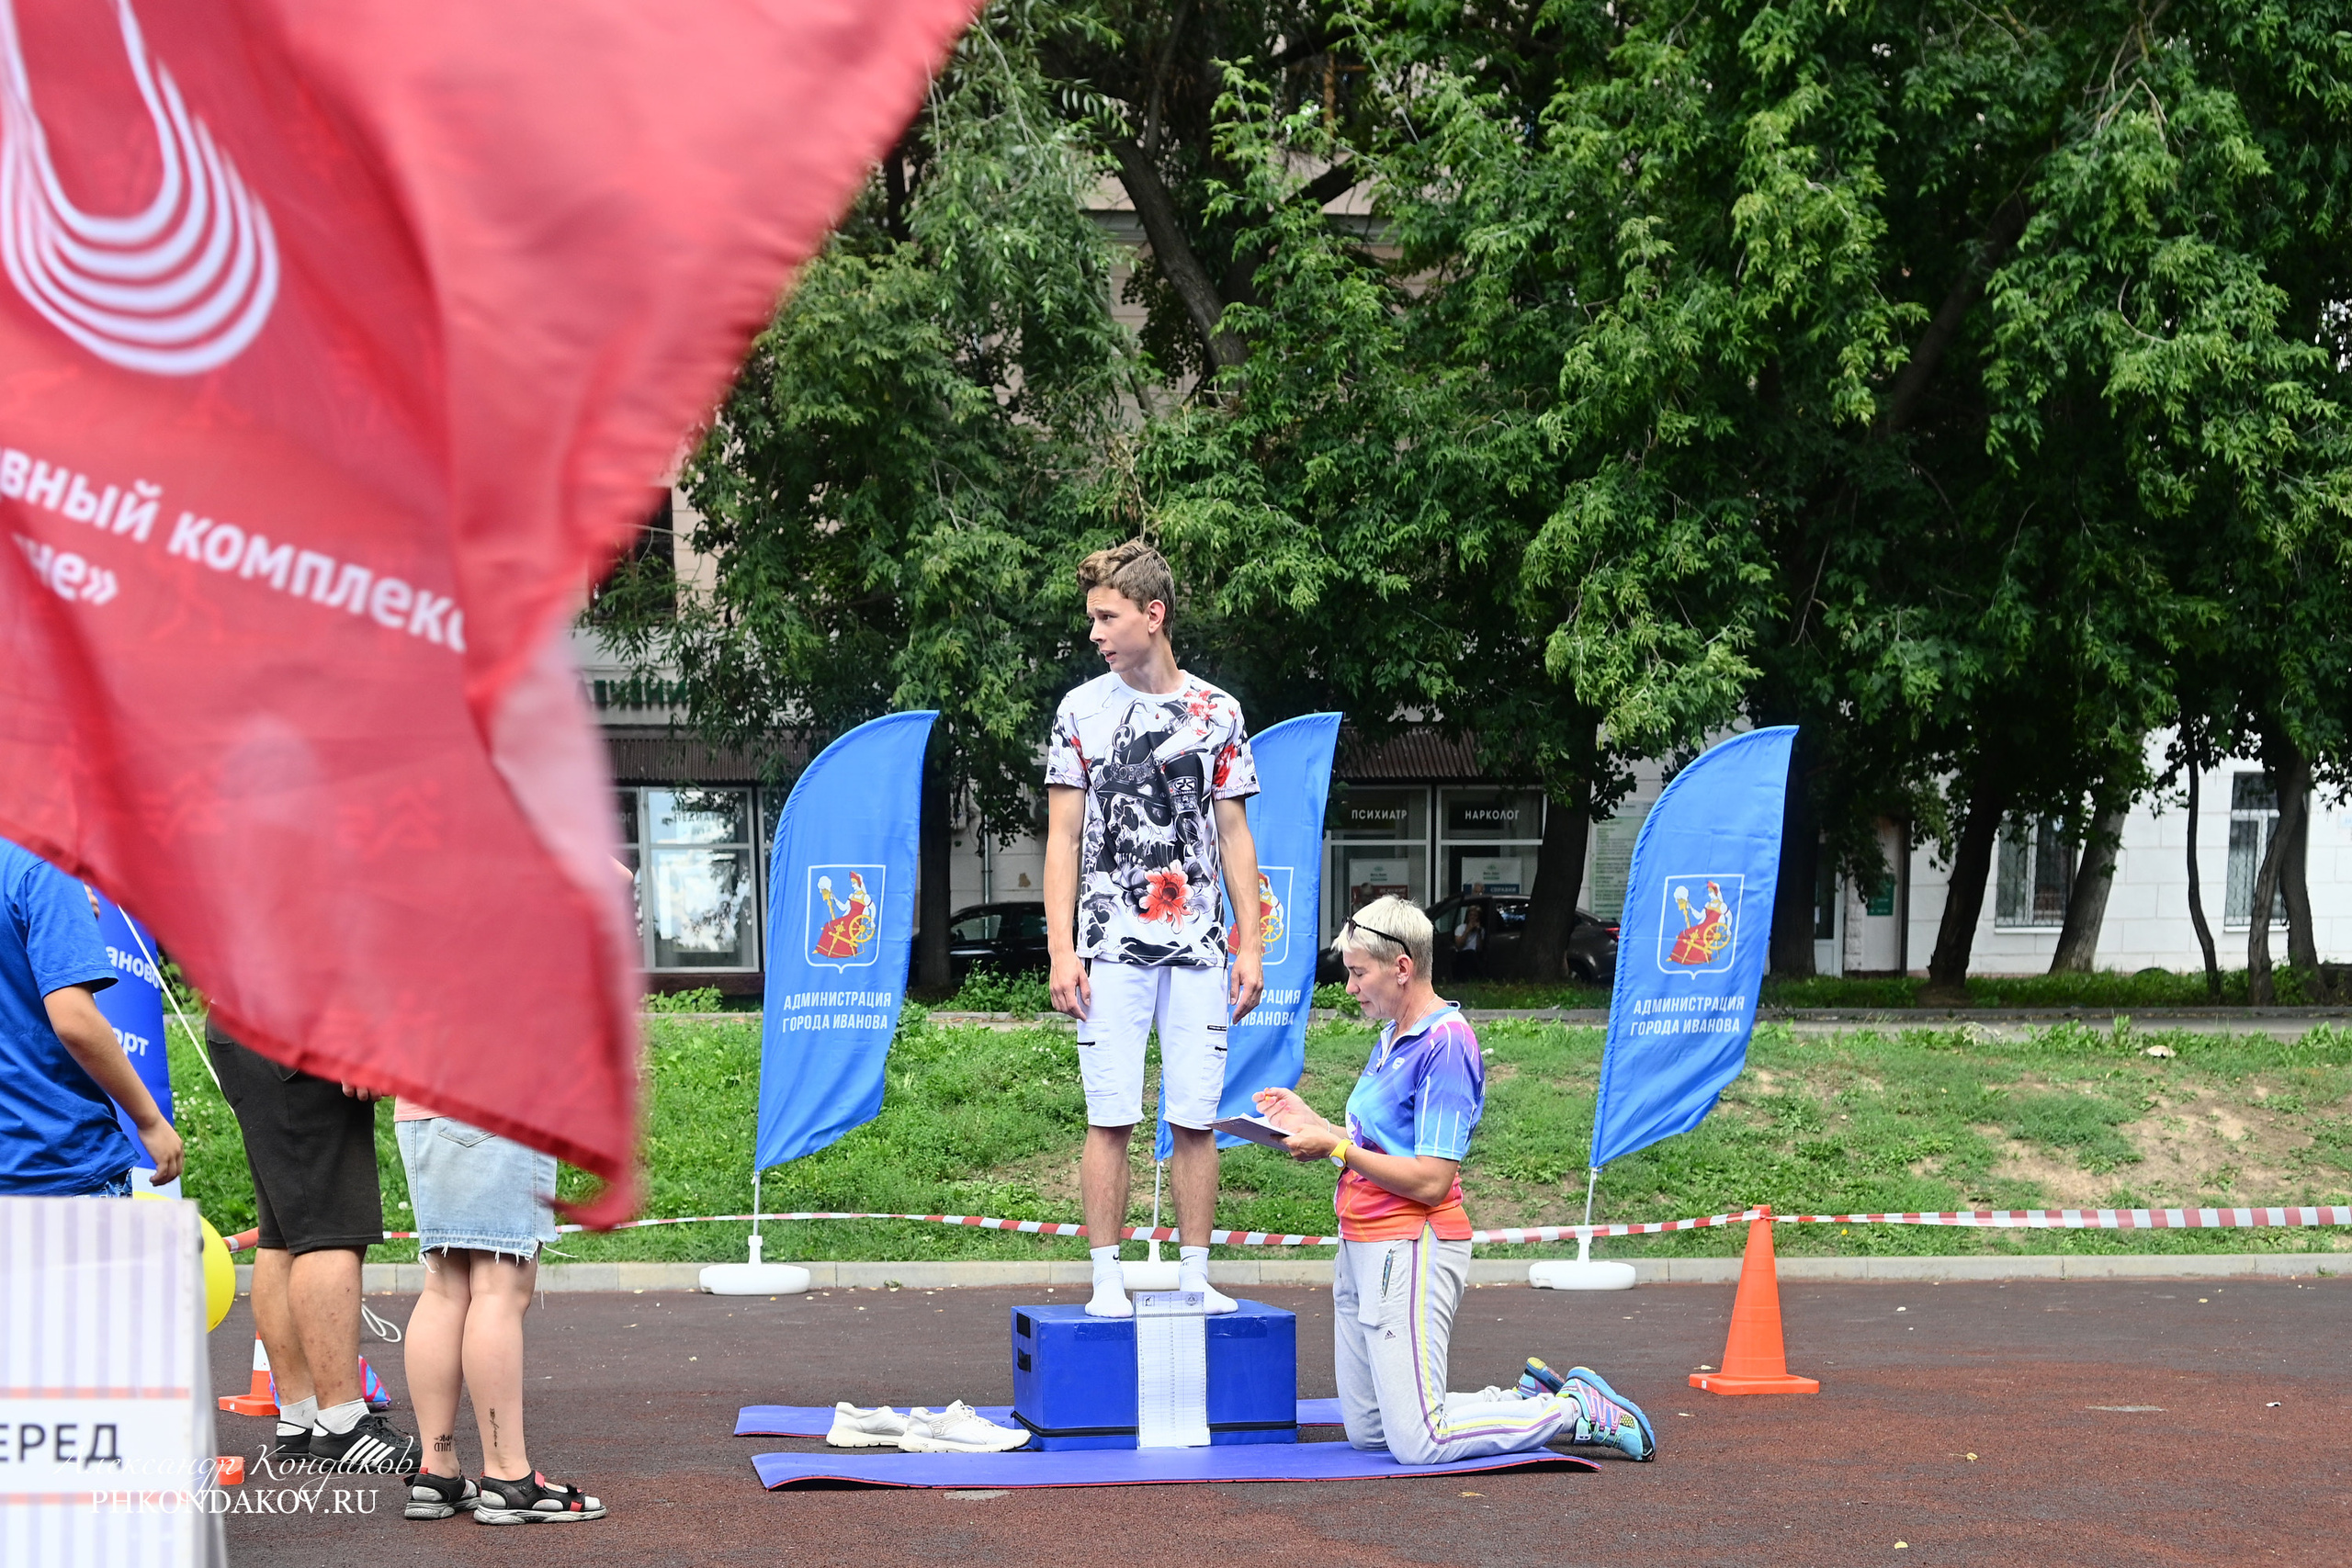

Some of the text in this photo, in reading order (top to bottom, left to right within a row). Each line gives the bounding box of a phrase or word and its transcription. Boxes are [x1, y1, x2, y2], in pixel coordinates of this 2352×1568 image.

[1351, 809, 1408, 820] ПСИХИАТР
[1464, 809, 1521, 820] НАРКОЛОГ
[783, 991, 892, 1010] АДМИНИСТРАЦИЯ
[1633, 996, 1746, 1016] АДМИНИСТРАЦИЯ
[782, 1013, 888, 1033] ГОРОДА ИВАНОВА
[1630, 1017, 1740, 1036] ГОРОДА ИВАНОВА
